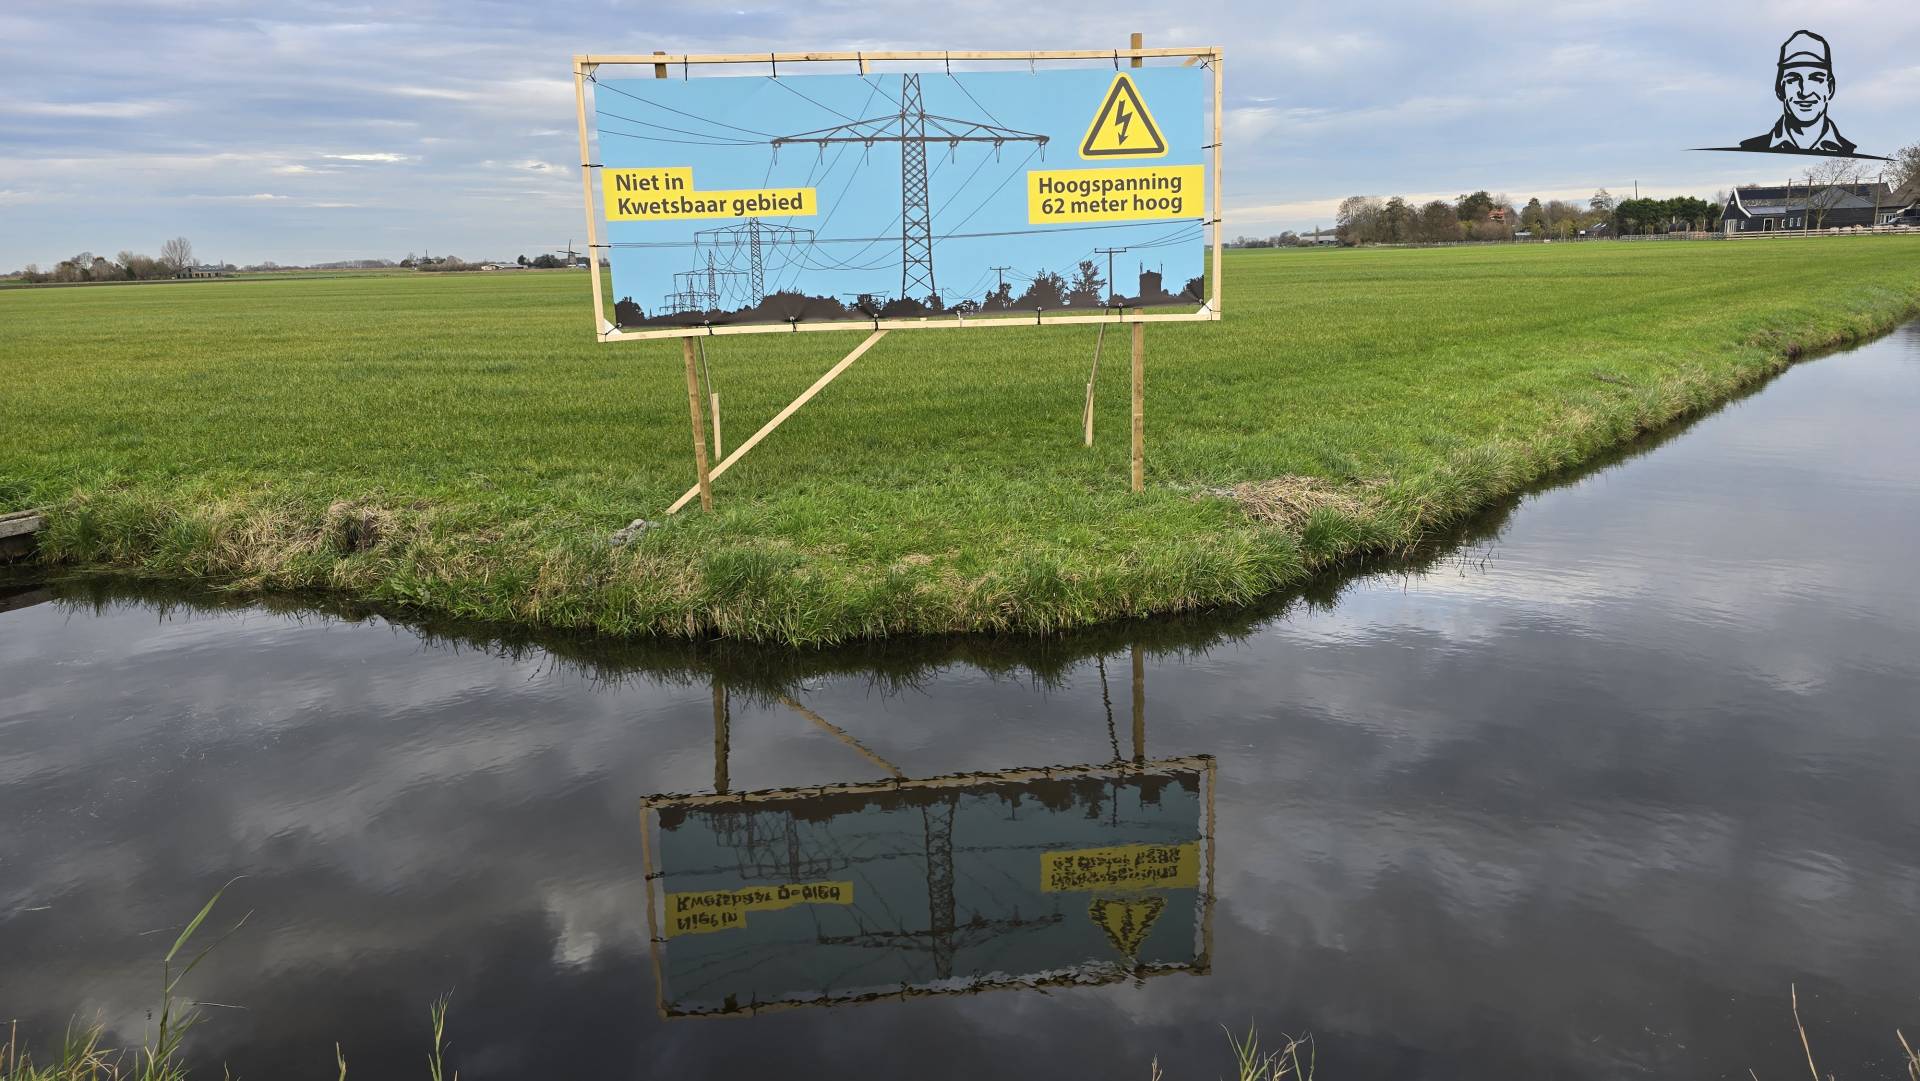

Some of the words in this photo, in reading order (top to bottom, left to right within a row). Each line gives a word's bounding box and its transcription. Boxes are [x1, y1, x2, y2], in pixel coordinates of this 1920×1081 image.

[615, 173, 660, 191] Niet
[665, 173, 684, 190] in
[1039, 173, 1182, 197] Hoogspanning
[617, 195, 728, 215] Kwetsbaar
[732, 192, 803, 216] gebied
[1041, 198, 1065, 215] 62
[1071, 197, 1128, 214] meter
[1133, 194, 1182, 213] hoog
